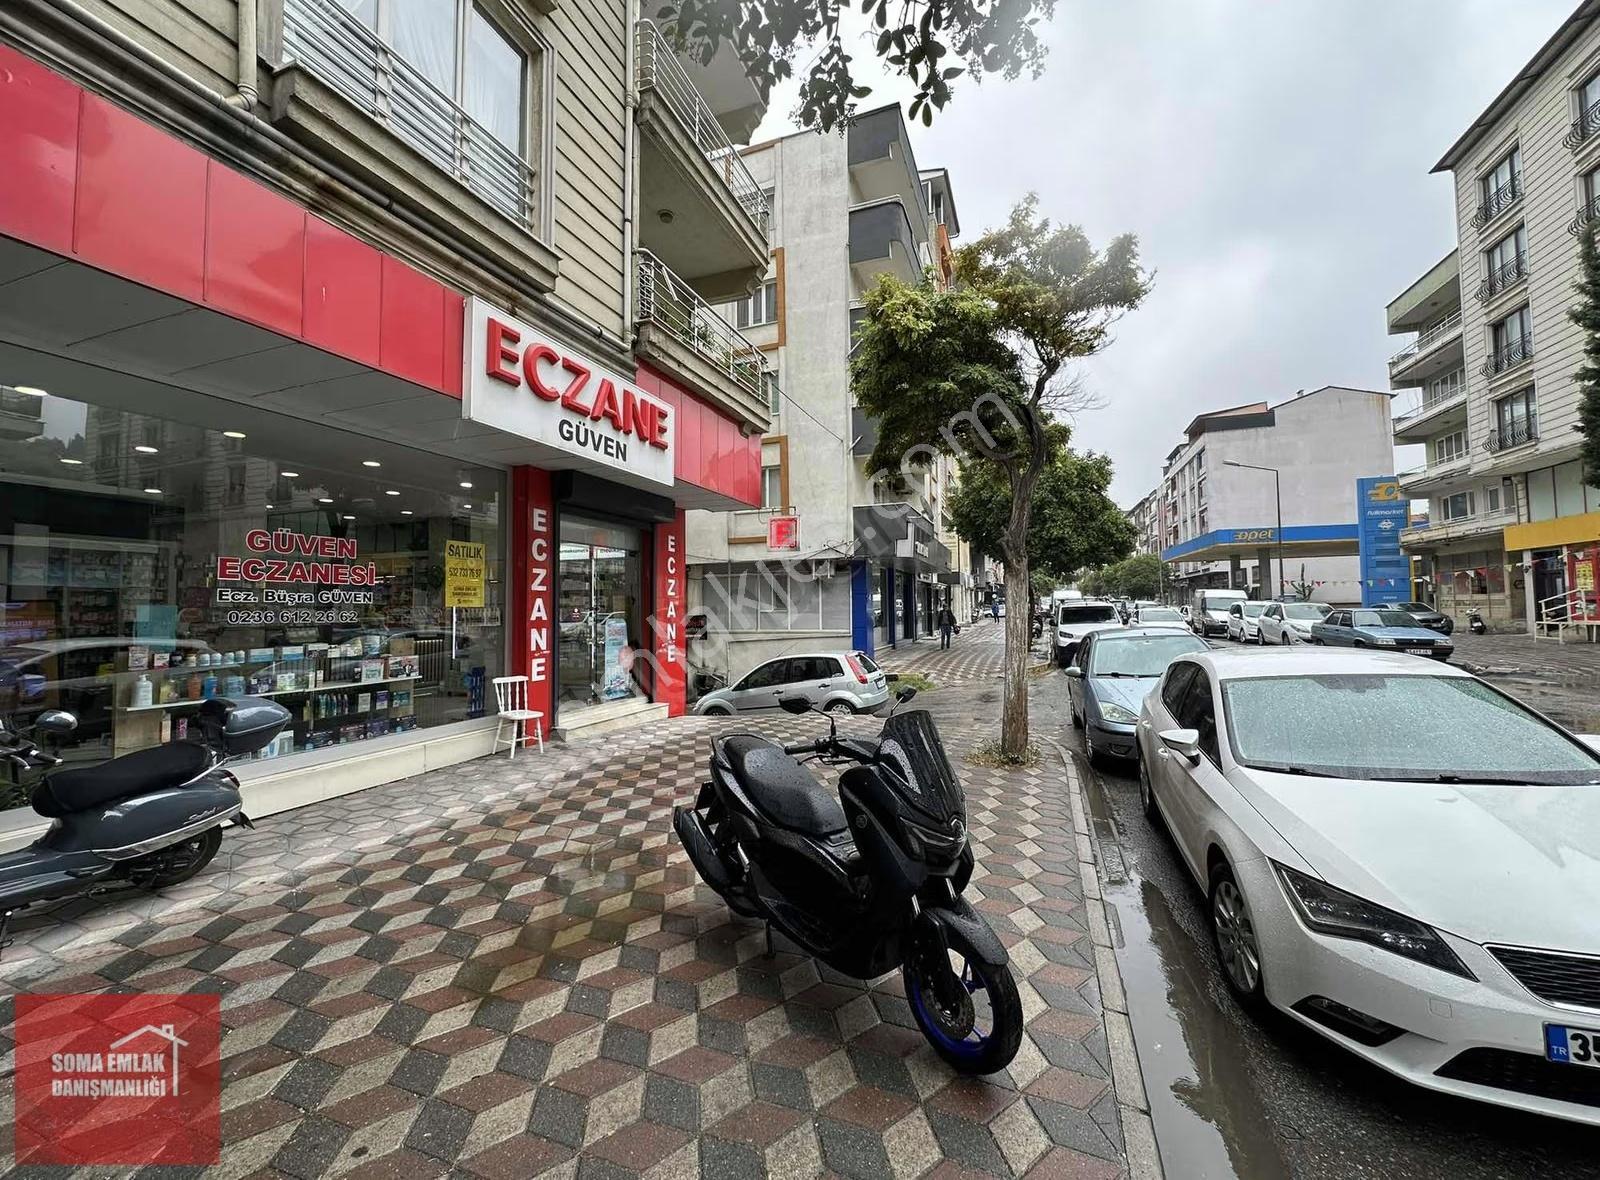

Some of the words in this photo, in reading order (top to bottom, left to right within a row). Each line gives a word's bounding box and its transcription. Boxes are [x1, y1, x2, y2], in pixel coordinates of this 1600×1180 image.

[486, 317, 668, 450] ECZANE
[559, 419, 627, 462] GÜVEN
[246, 528, 357, 559] GÜVEN
[1234, 529, 1275, 542] opet
[448, 544, 483, 559] SATILIK
[217, 557, 376, 586] ECZANESİ
[217, 588, 258, 603] Ecz.
[264, 589, 314, 606] Büşra
[318, 590, 373, 604] GÜVEN
[530, 508, 548, 682] ECZANE
[666, 535, 676, 663] ECZANE
[228, 610, 274, 625] 0236
[280, 611, 311, 624] 612
[315, 611, 335, 624] 26
[339, 611, 358, 624] 62
[1552, 1046, 1567, 1056] TR
